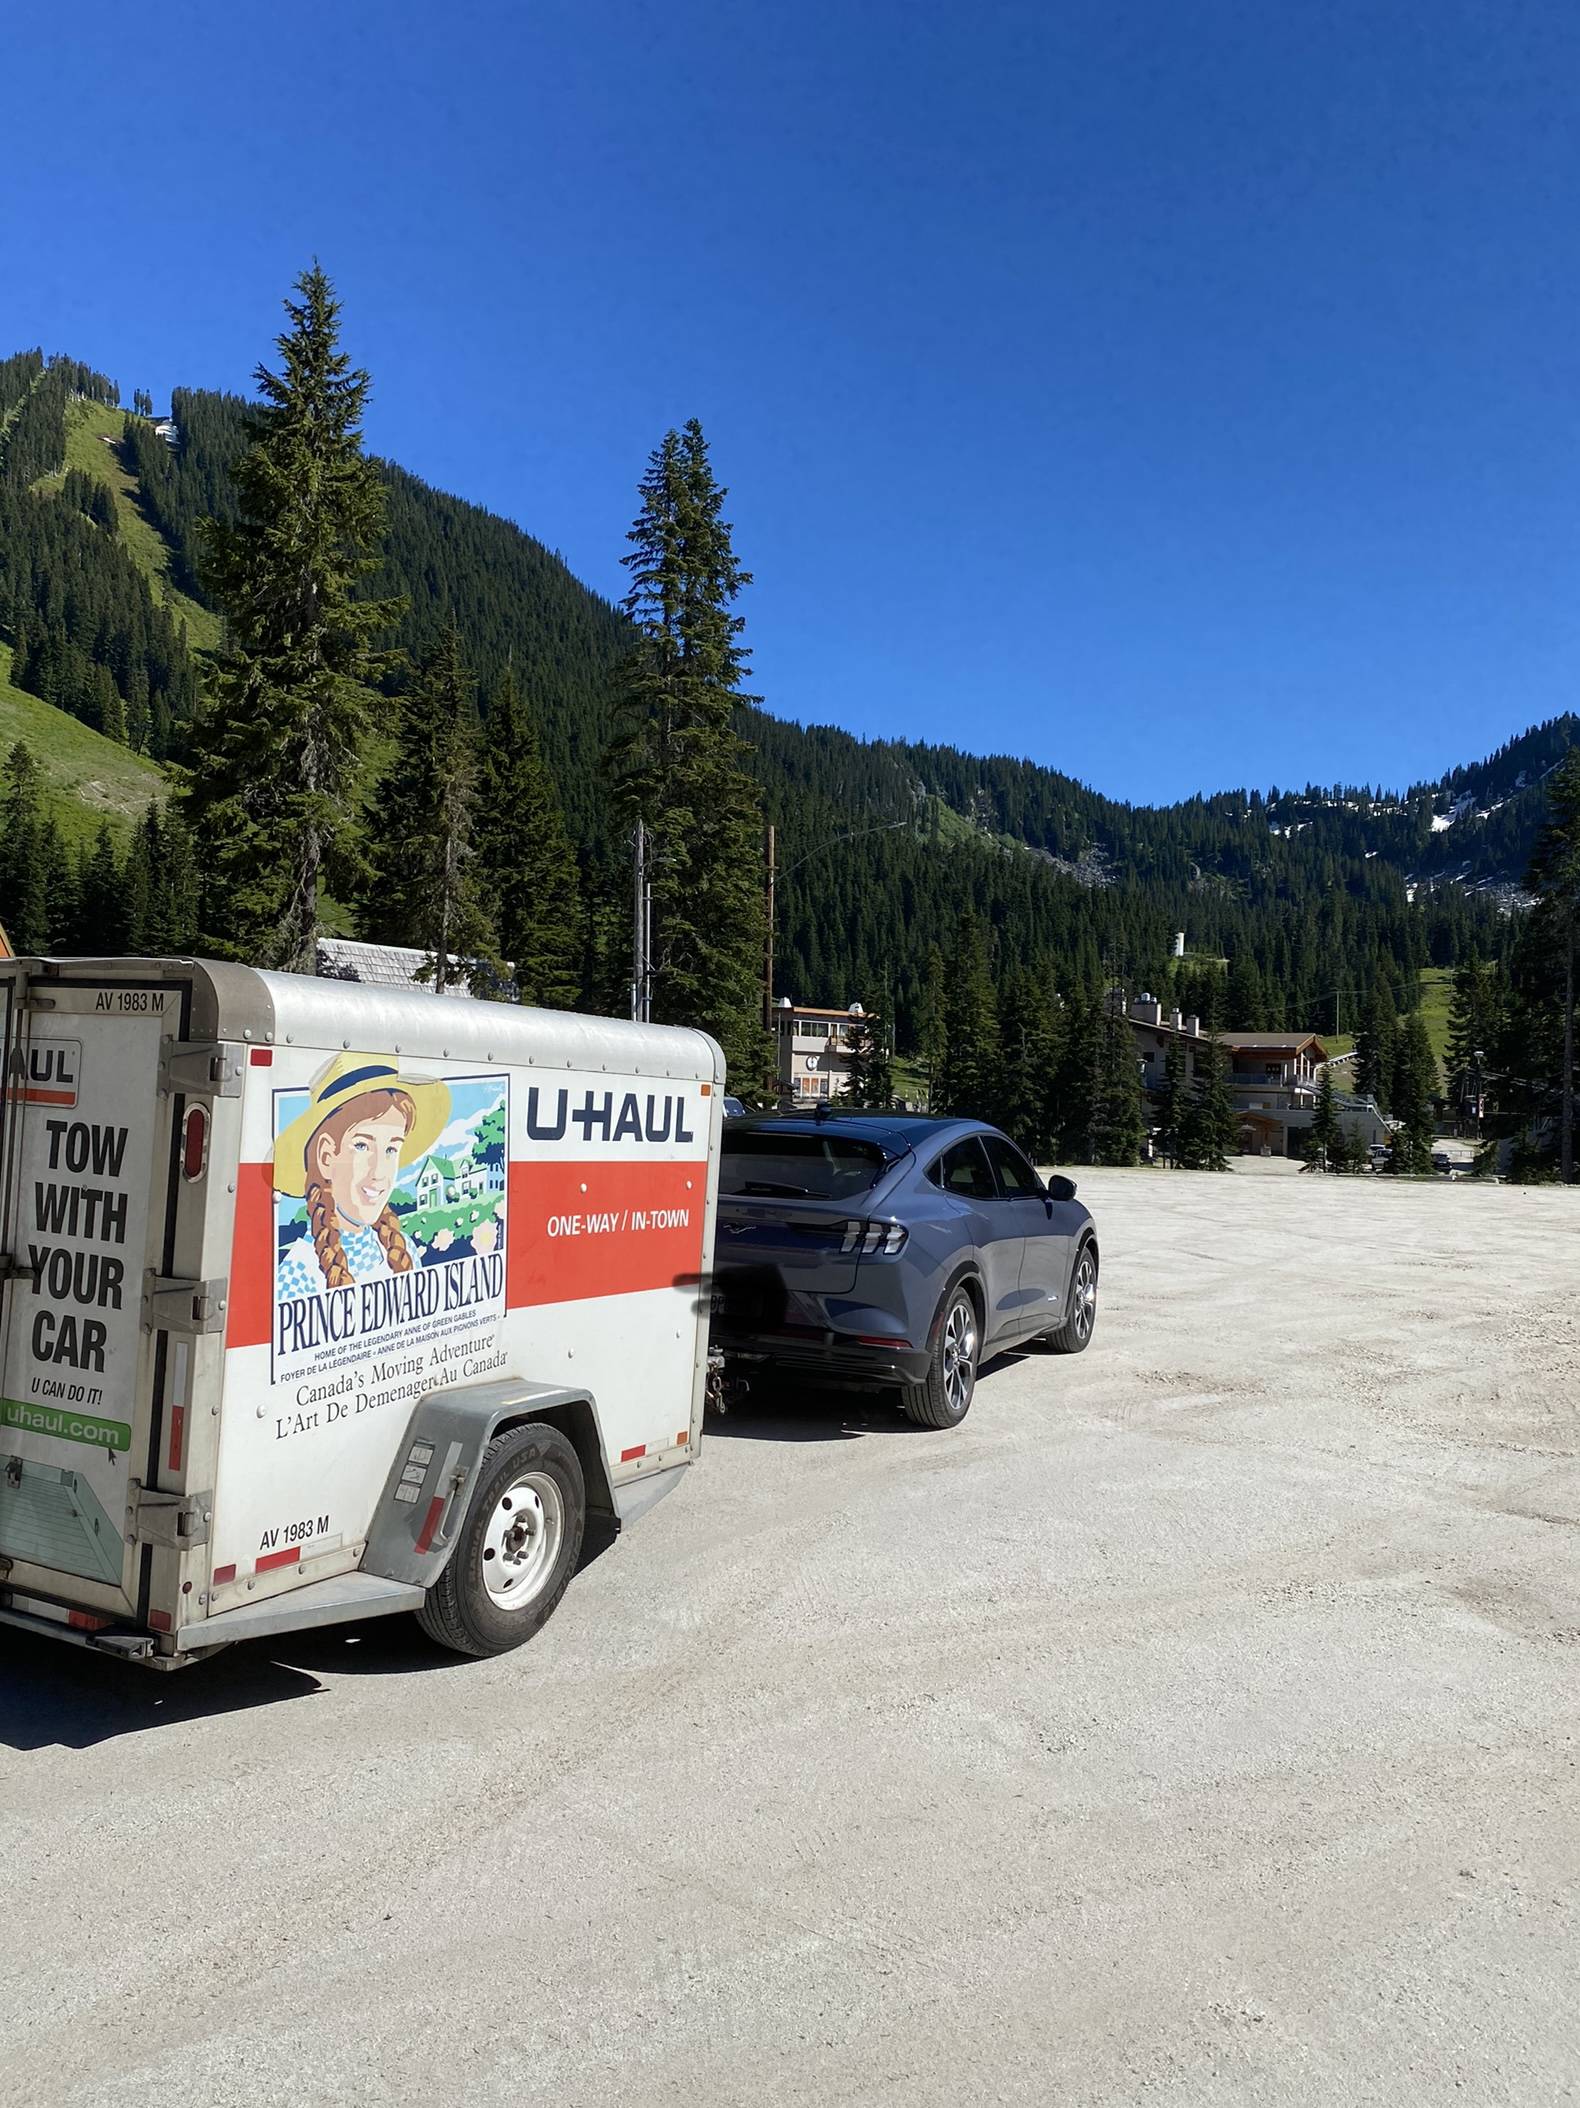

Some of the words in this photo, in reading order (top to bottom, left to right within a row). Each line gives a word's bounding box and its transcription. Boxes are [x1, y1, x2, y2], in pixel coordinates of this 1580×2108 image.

[96, 992, 113, 1010] AV
[118, 992, 147, 1011] 1983
[152, 992, 164, 1011] M
[0, 1048, 73, 1083] AUL
[46, 1119, 129, 1177] TOW
[35, 1181, 128, 1243] WITH
[547, 1212, 619, 1237] ONE-WAY
[621, 1209, 628, 1231] /
[631, 1209, 689, 1230] IN-TOWN
[28, 1244, 124, 1310] YOUR
[278, 1287, 356, 1356] PRINCE
[360, 1268, 439, 1334] EDWARD
[443, 1253, 504, 1311] ISLAND
[32, 1310, 107, 1373] CAR
[280, 1369, 305, 1383] FOYER
[306, 1365, 317, 1376] DE
[318, 1362, 328, 1373] LA
[377, 1342, 395, 1355] ANNE
[396, 1339, 406, 1350] DE
[406, 1337, 415, 1347] LA
[416, 1331, 439, 1344] MAISON
[440, 1326, 453, 1337] AUX
[453, 1319, 479, 1333] PIGNONS
[480, 1314, 497, 1325] VERTS
[314, 1348, 336, 1361] HOME
[338, 1345, 348, 1355] OF
[349, 1340, 362, 1350] THE
[363, 1329, 402, 1347] LEGENDARY
[404, 1324, 422, 1336] ANNE
[422, 1321, 432, 1331] OF
[432, 1315, 453, 1328] GREEN
[454, 1309, 477, 1322] GABLES
[31, 1377, 40, 1393] U
[42, 1380, 66, 1398] CAN
[67, 1384, 85, 1402] DO
[87, 1388, 103, 1405] IT!
[276, 1413, 319, 1439] L'Art
[326, 1401, 349, 1423] De
[355, 1374, 436, 1413] Demenager
[440, 1367, 457, 1386] Au
[296, 1371, 364, 1406] Canada's
[370, 1355, 423, 1384] Moving
[7, 1405, 119, 1444] uhaul.com
[260, 1528, 279, 1550] AV
[283, 1519, 313, 1543] 1983
[317, 1515, 329, 1535] M
